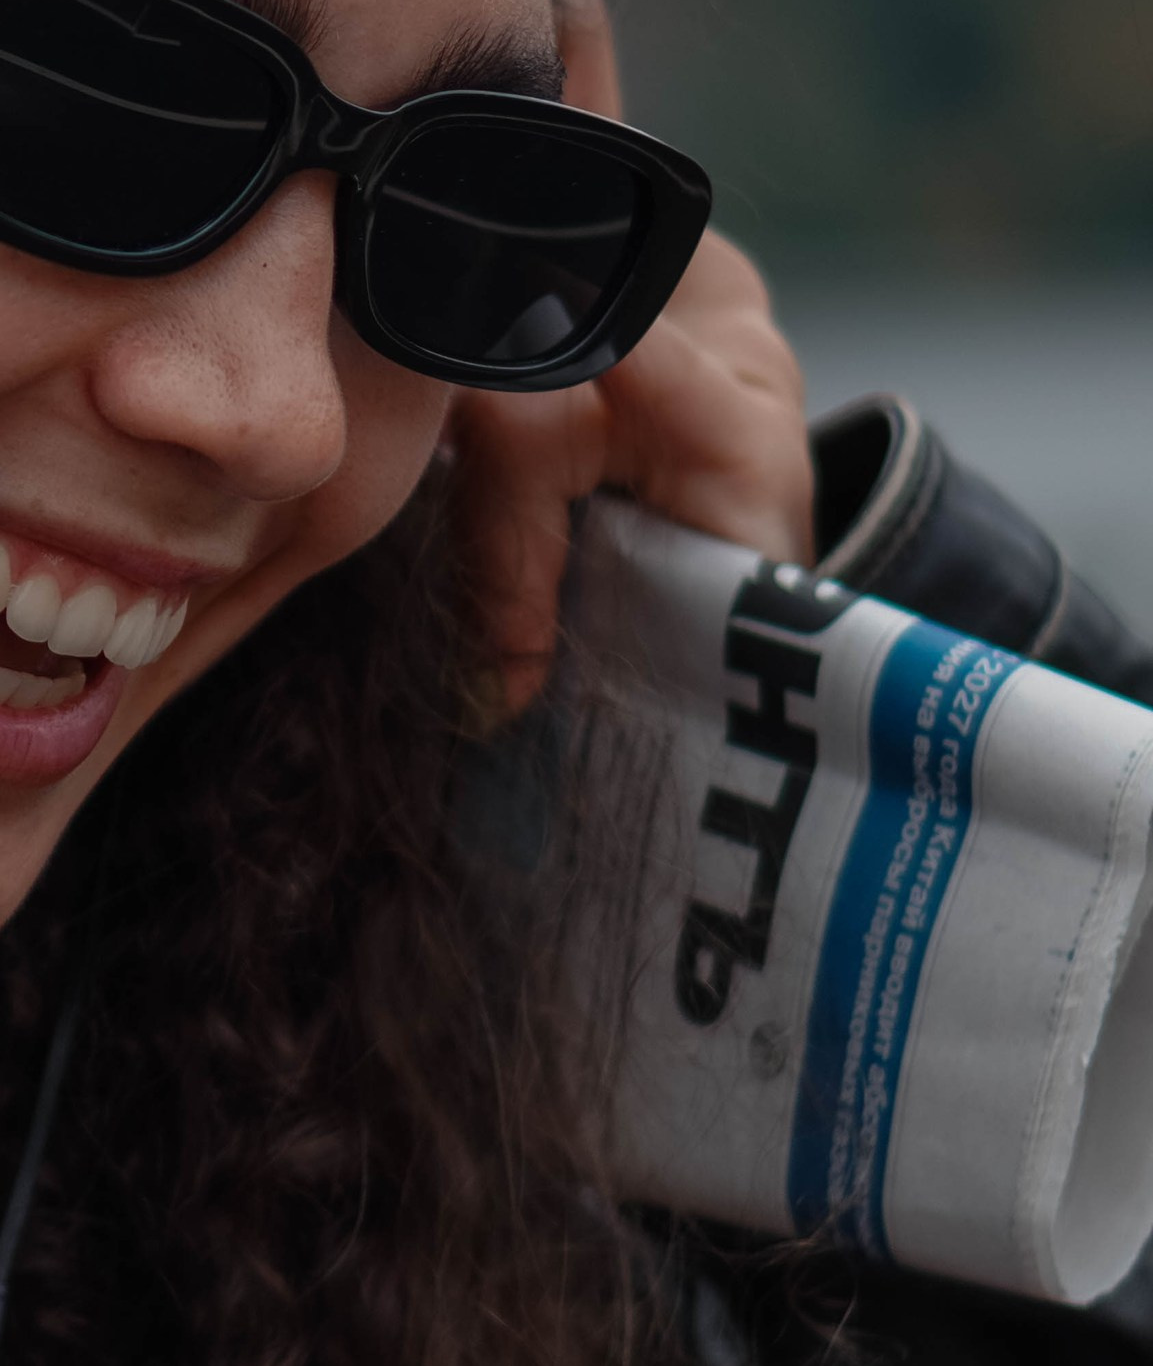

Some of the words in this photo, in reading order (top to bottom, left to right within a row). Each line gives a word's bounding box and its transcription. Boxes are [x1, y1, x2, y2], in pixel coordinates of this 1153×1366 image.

[917, 685, 943, 731] на
[948, 656, 1003, 737] 2027
[884, 735, 935, 892] выбросы
[938, 738, 960, 819] года
[901, 823, 957, 930] Китай
[873, 934, 914, 1062] вводит
